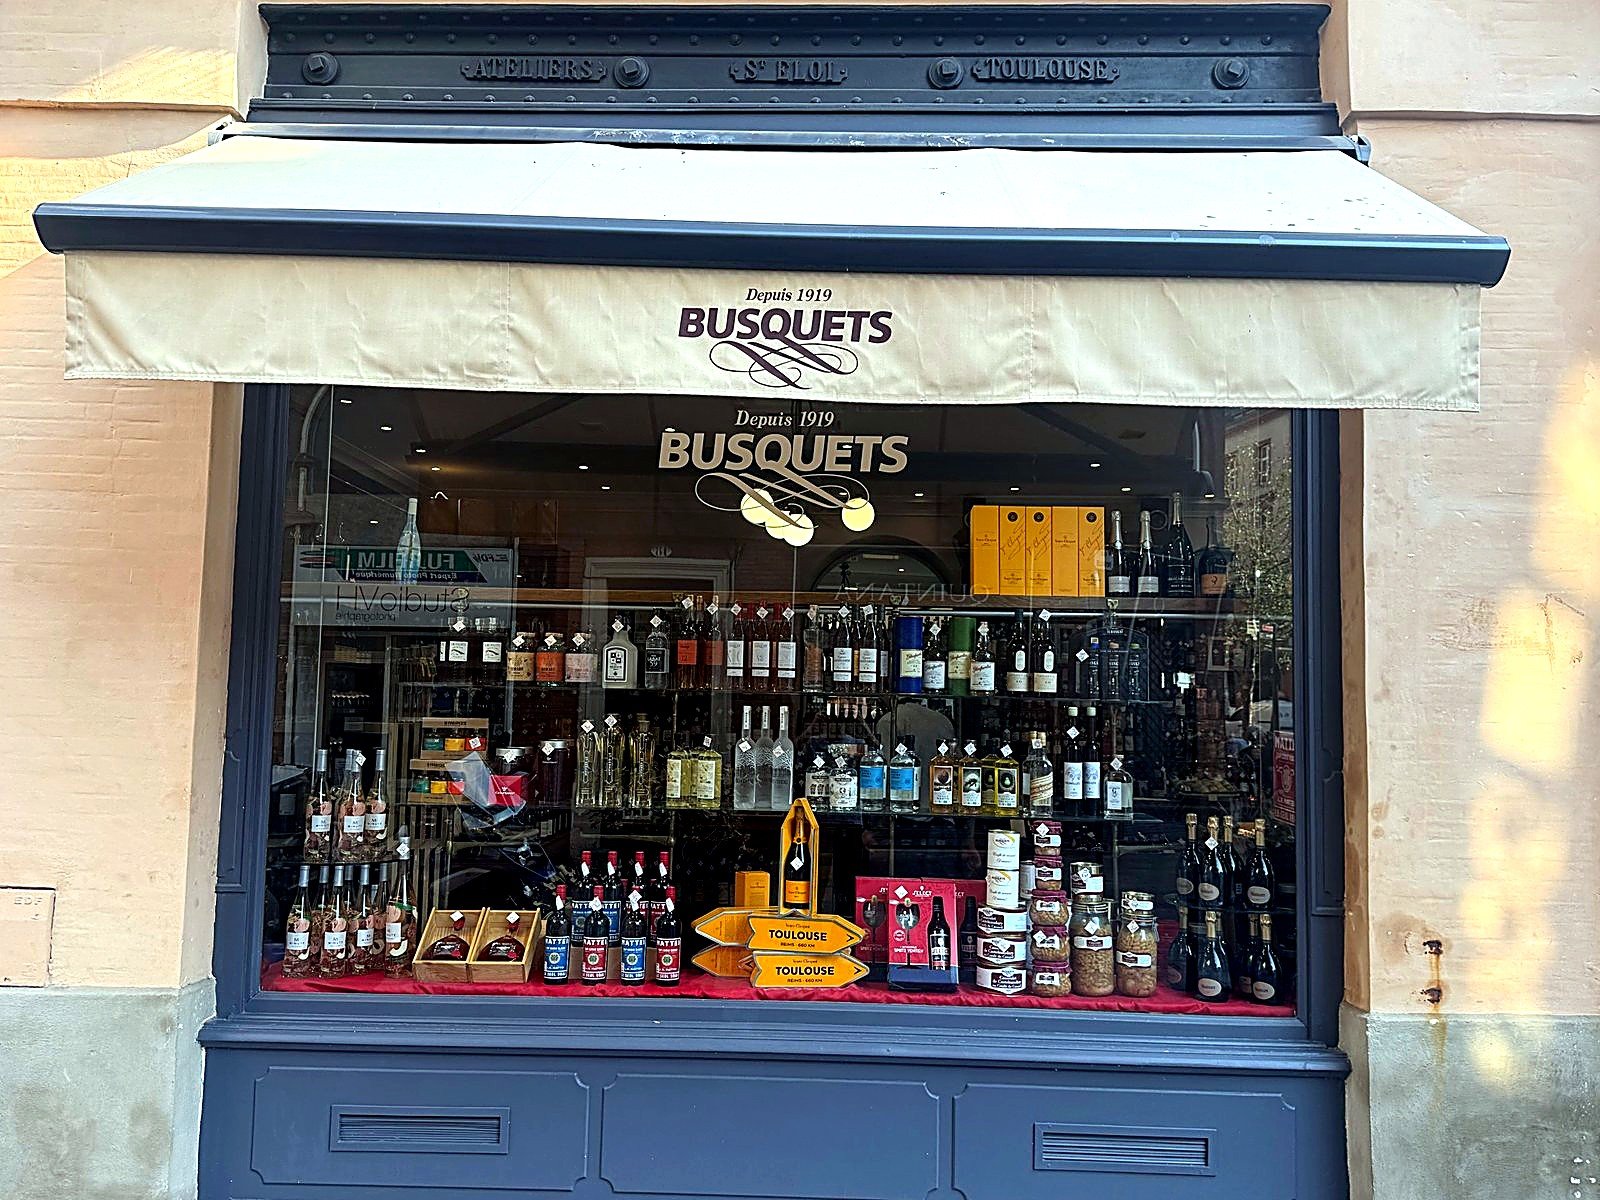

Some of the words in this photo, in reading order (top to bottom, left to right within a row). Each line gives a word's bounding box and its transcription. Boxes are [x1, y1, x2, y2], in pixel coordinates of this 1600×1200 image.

[473, 58, 593, 80] ATELIERS
[776, 59, 834, 81] ELOI
[985, 58, 1108, 81] TOULOUSE
[745, 287, 793, 304] Depuis
[796, 288, 833, 302] 1919
[678, 307, 893, 344] BUSQUETS
[734, 410, 793, 429] Depuis
[797, 411, 835, 428] 1919
[658, 431, 909, 474] BUSQUETS
[768, 929, 828, 942] TOULOUSE
[775, 966, 835, 976] TOULOUSE
